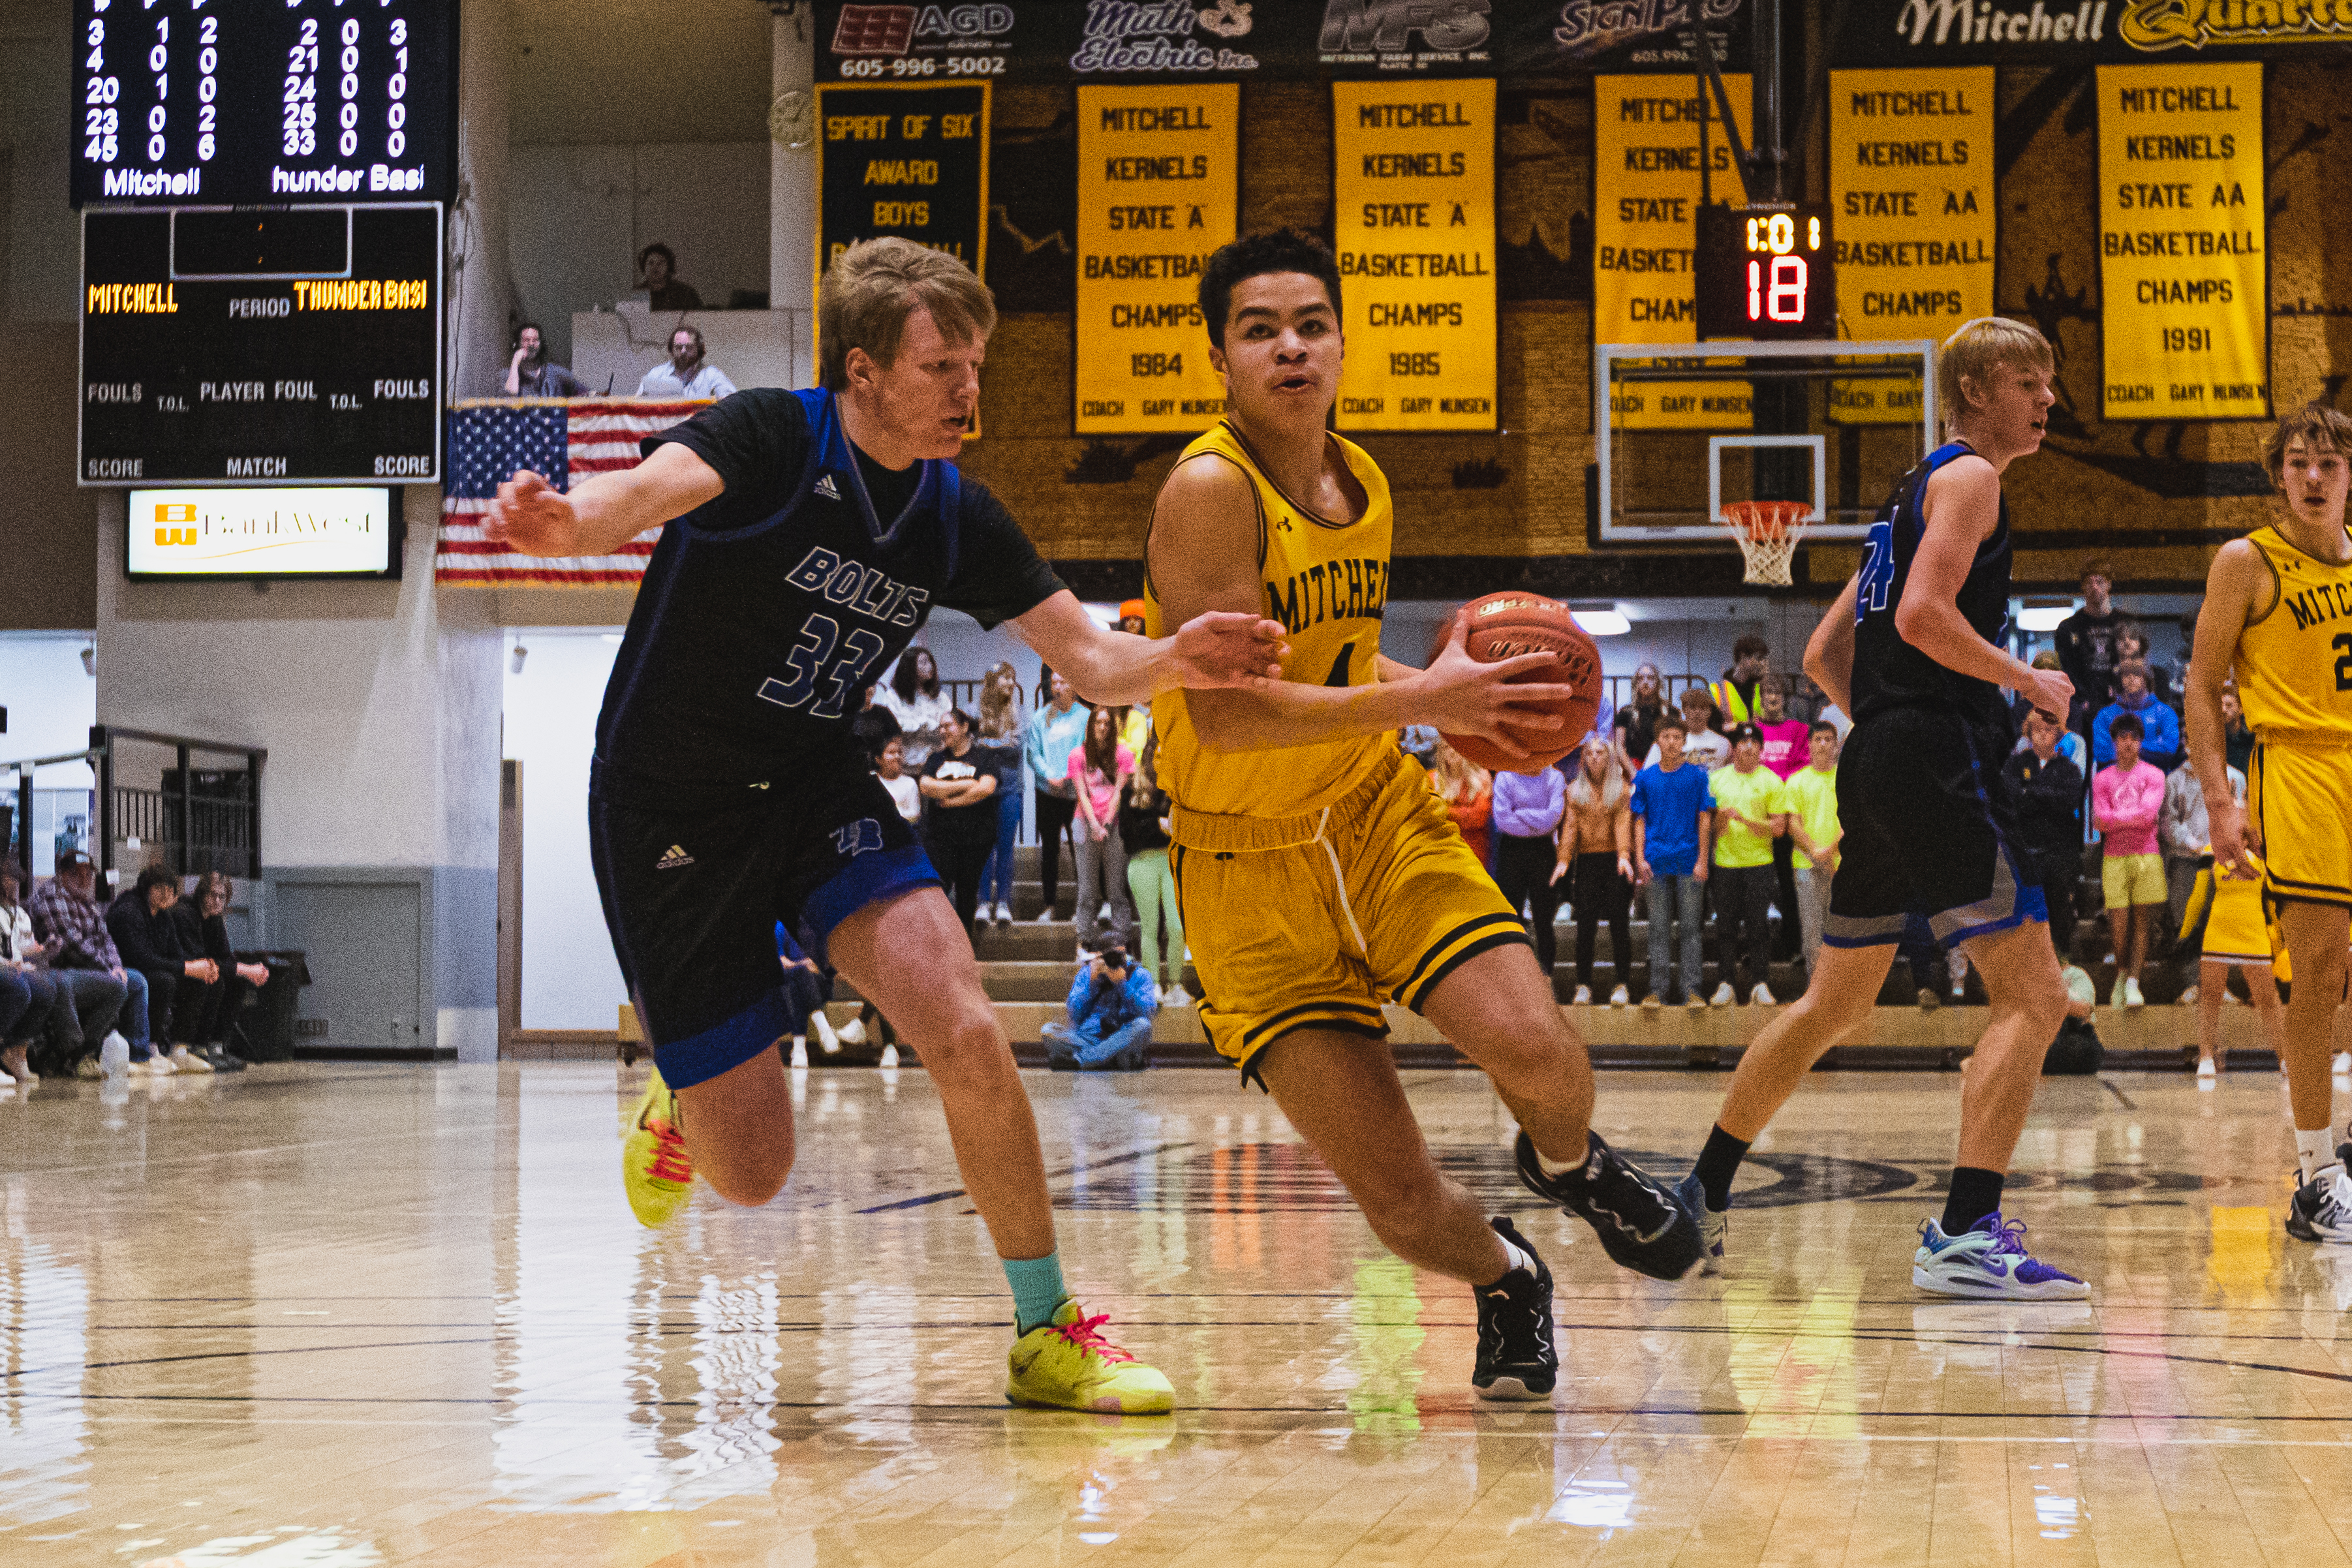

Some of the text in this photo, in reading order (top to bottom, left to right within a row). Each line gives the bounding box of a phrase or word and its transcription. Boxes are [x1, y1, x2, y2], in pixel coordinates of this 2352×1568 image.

[88, 17, 217, 46] 3 1 2
[301, 18, 407, 46] 2 0 3
[915, 3, 1014, 36] AGD
[1896, 0, 2108, 45] Mitchell
[87, 44, 217, 74] 4 0 0
[288, 45, 408, 72] 21 0 1
[1070, 35, 1215, 71] Electric
[86, 73, 217, 104] 20 1 0
[284, 72, 407, 102] 24 0 0
[2120, 85, 2240, 113] MITCHELL
[283, 102, 406, 130] 25 0 0
[1359, 102, 1472, 128] MITCHELL
[1853, 91, 1973, 116] MITCHELL
[85, 104, 216, 135] 23 0 2
[827, 114, 974, 141] SPIRIT OF SIX
[1102, 106, 1212, 131] MITCHELL
[85, 134, 215, 162] 45 0 6
[283, 129, 405, 158] 33 0 0
[1858, 139, 1968, 166] KERNELS
[2127, 134, 2236, 161] KERNELS
[1106, 155, 1208, 181] KERNELS
[1363, 152, 1465, 177] KERNELS
[1625, 146, 1730, 171] KERNES
[104, 168, 200, 196] Mitchell
[273, 165, 365, 192] hunder
[864, 160, 939, 185] AWARD
[1845, 191, 1919, 216] STATE
[2118, 183, 2193, 209] STATE
[873, 201, 929, 226] BOYS
[1109, 206, 1175, 230] STATE
[1363, 202, 1430, 227] STATE
[1619, 198, 1688, 223] STATE
[1834, 239, 1990, 266] BASKETBALL
[2103, 232, 2261, 258] BASKETBALL
[1340, 252, 1489, 277] BASKETBALL
[1600, 245, 1695, 273] BASKET
[88, 283, 179, 314] MITCHELL
[293, 280, 382, 311] THUNDER
[1747, 255, 1808, 323] 18
[2137, 279, 2233, 305] CHAMPS
[229, 298, 290, 318] PERIOD
[1111, 304, 1202, 328] CHAMPS
[1369, 302, 1463, 326] CHAMPS
[1863, 291, 1962, 316] CHAMPS
[2163, 328, 2212, 353] 1991
[1132, 352, 1183, 377] 1984
[1389, 352, 1441, 377] 1985
[87, 382, 142, 403] FOULS
[200, 380, 318, 401] PLAYER FOUL
[373, 378, 430, 399] FOULS
[2107, 384, 2155, 403] COACH
[2170, 384, 2205, 403] GARY
[1083, 400, 1124, 416] COACH
[1143, 399, 1175, 415] GARY
[1342, 398, 1384, 415] COACH
[1400, 398, 1433, 414] GARY
[88, 458, 143, 478] SCORE
[226, 457, 287, 477] MATCH
[374, 455, 430, 476] SCORE
[784, 546, 929, 627] BOLTS
[756, 612, 884, 718] 33
